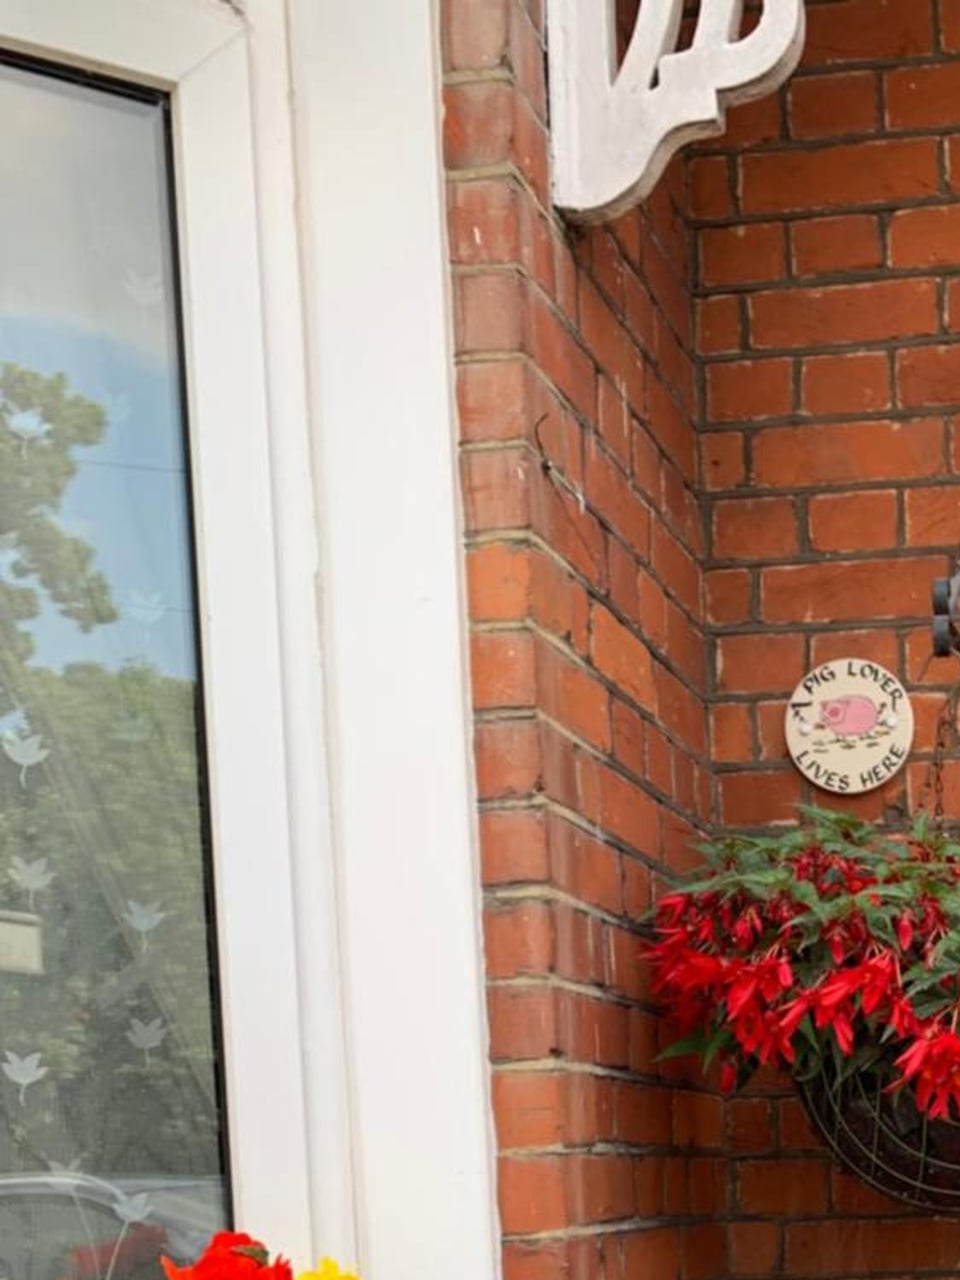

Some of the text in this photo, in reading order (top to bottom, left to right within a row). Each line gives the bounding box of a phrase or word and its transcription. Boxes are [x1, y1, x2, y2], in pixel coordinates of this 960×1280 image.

[802, 666, 836, 695] PIG
[848, 661, 903, 713] LOVER
[796, 744, 904, 791] LIVES HERE
